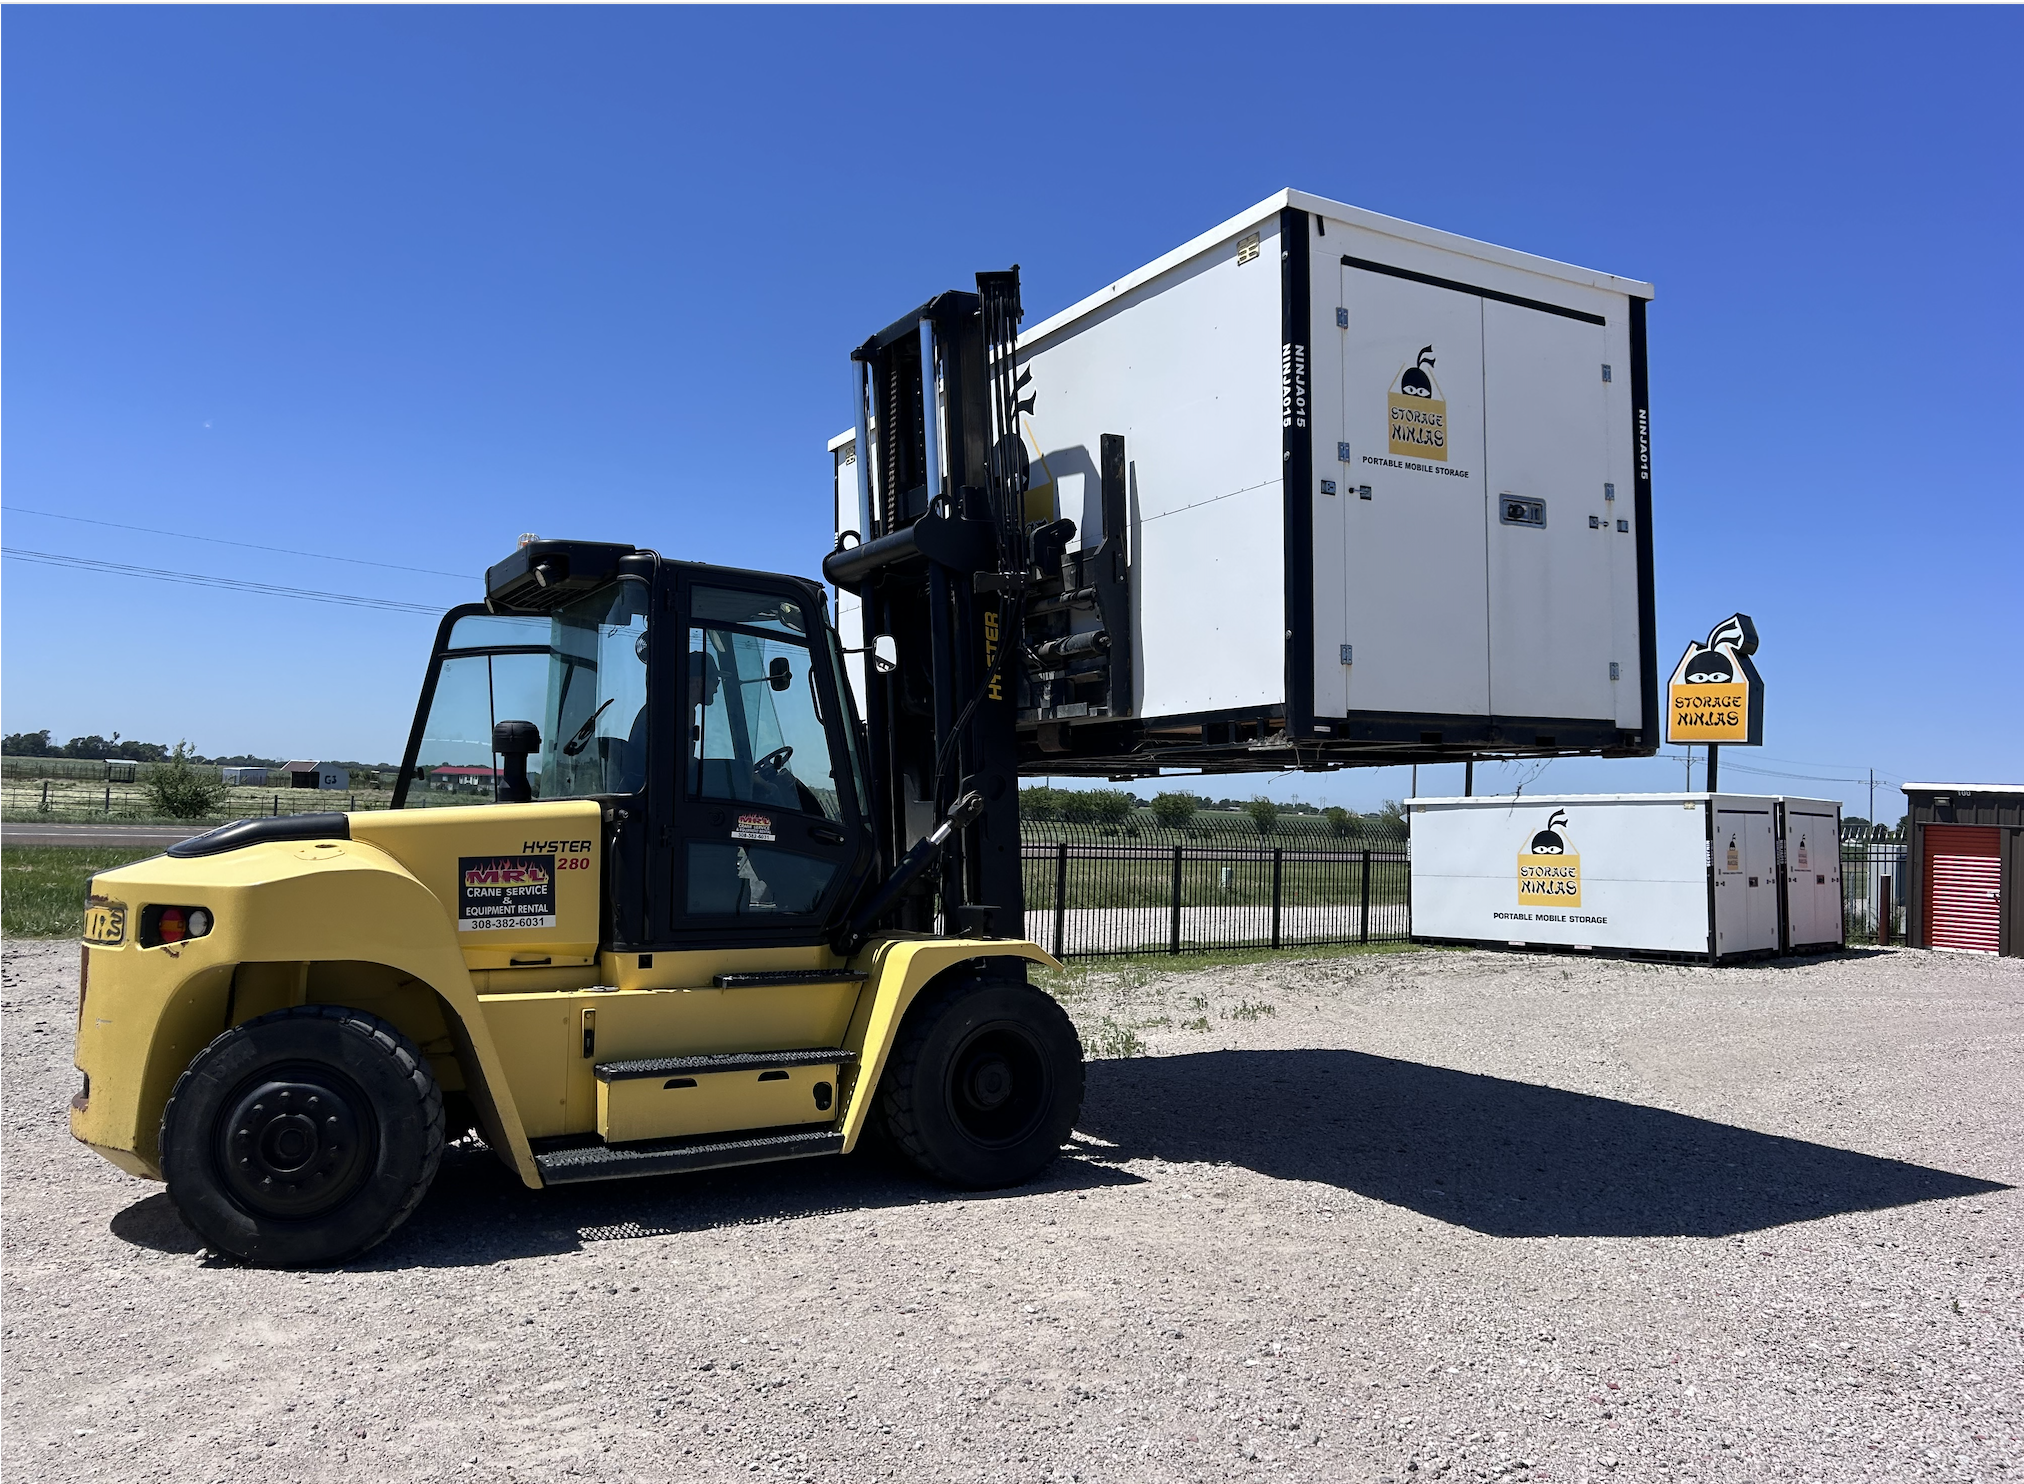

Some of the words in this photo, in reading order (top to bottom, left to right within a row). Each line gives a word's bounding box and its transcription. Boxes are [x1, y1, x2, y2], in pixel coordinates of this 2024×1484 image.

[1282, 343, 1292, 428] NINJA015
[1295, 344, 1306, 428] NINJA015
[1391, 406, 1444, 427] STORAGE
[1391, 423, 1445, 447] NINJAS
[1639, 408, 1648, 480] NINJA015
[1362, 455, 1403, 469] PORTABLE
[1404, 461, 1433, 473] MOBILE
[1435, 466, 1469, 478] STORAGE
[1675, 696, 1742, 708] STORAGE
[1677, 711, 1739, 726] NINJAS
[324, 775, 337, 785] G3
[522, 840, 592, 854] HYSTER
[557, 857, 590, 870] 280
[466, 868, 547, 885] MRL
[1520, 866, 1577, 878] STORAGE
[466, 887, 502, 898] CRANE
[506, 884, 548, 896] SERVICE
[1520, 880, 1577, 896] NINJAS
[502, 896, 513, 905] &
[466, 904, 516, 917] EQUIPMENT
[517, 904, 549, 914] RENTAL
[471, 917, 544, 930] 308-382-6031
[1493, 912, 1533, 921] PORTABLE
[1535, 913, 1567, 923] MOBILE
[1569, 915, 1608, 924] STORAGE
